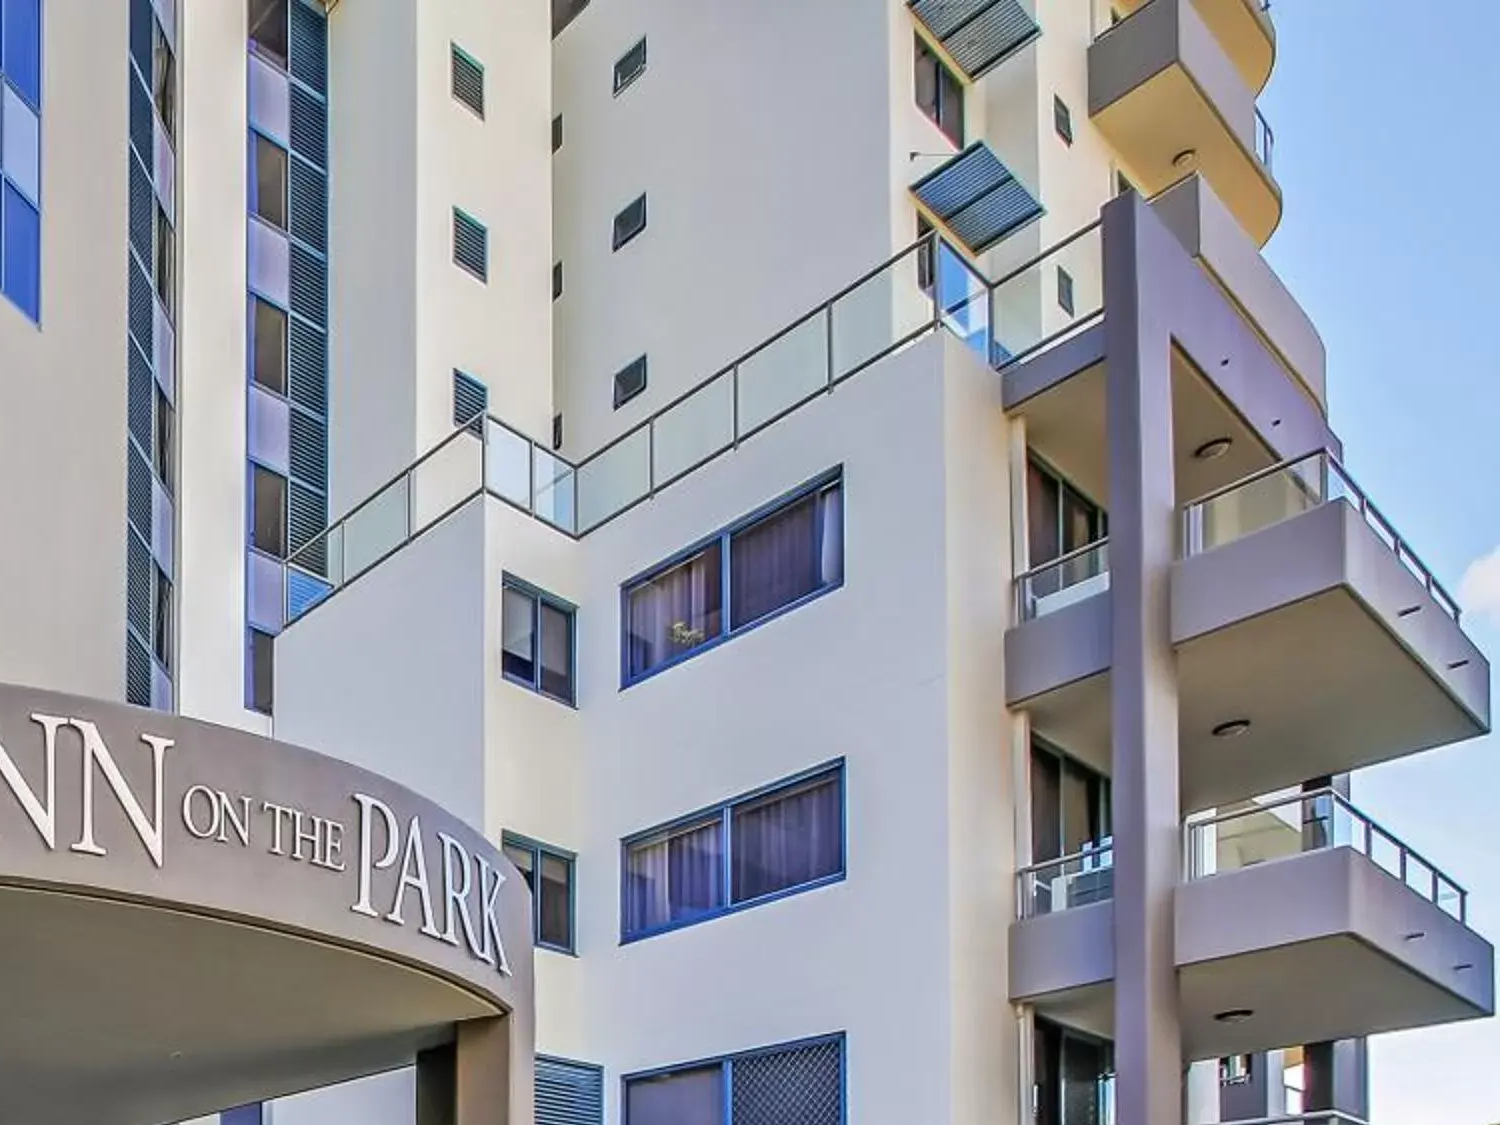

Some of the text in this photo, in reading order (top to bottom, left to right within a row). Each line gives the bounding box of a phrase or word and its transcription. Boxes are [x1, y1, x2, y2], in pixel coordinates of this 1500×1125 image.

[181, 785, 252, 848] ON
[261, 801, 346, 872] THE
[350, 792, 513, 977] PARK
